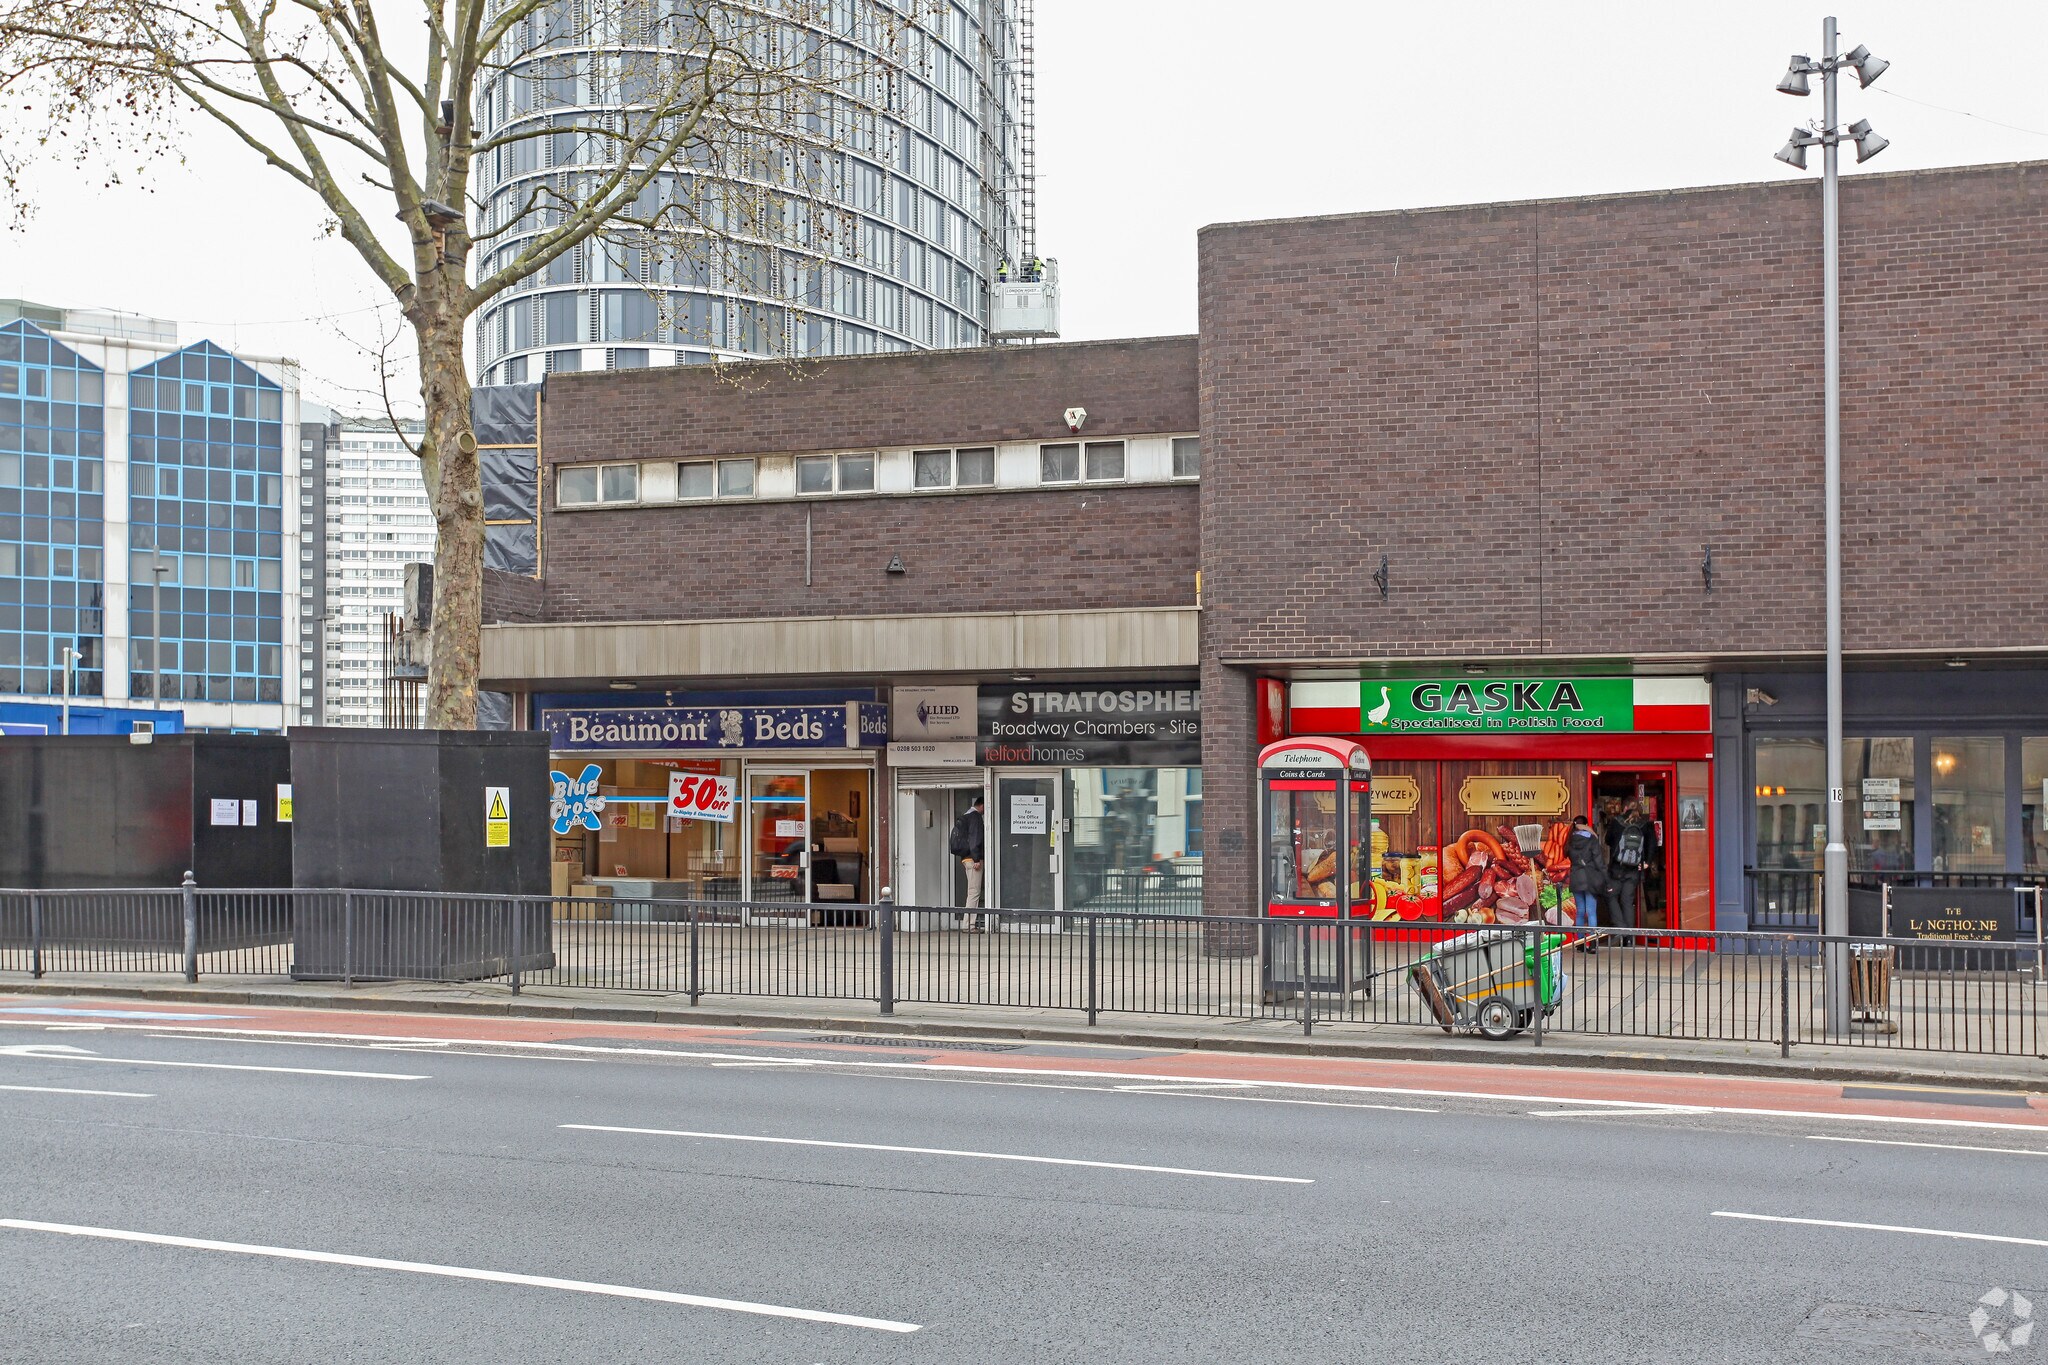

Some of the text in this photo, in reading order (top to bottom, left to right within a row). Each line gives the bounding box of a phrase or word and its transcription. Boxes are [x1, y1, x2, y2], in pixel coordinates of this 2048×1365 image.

[918, 705, 959, 715] ALLIED
[569, 713, 823, 742] Beaumont Beds
[860, 715, 887, 734] Beds
[992, 720, 1070, 738] Broadway
[1074, 720, 1155, 735] Chambers
[1169, 719, 1197, 734] Site
[1391, 716, 1604, 730] Specialised in Polish Food
[984, 744, 1085, 761] telfordhomes
[1284, 754, 1322, 764] Telephone
[1279, 770, 1326, 778] Coins & Cards
[553, 777, 599, 799] Blue
[1832, 788, 1843, 801] 18
[1491, 790, 1537, 802] WĘDLINY
[549, 796, 607, 820] Cross
[1945, 907, 1961, 915] TE
[1917, 932, 1953, 940] Traditional
